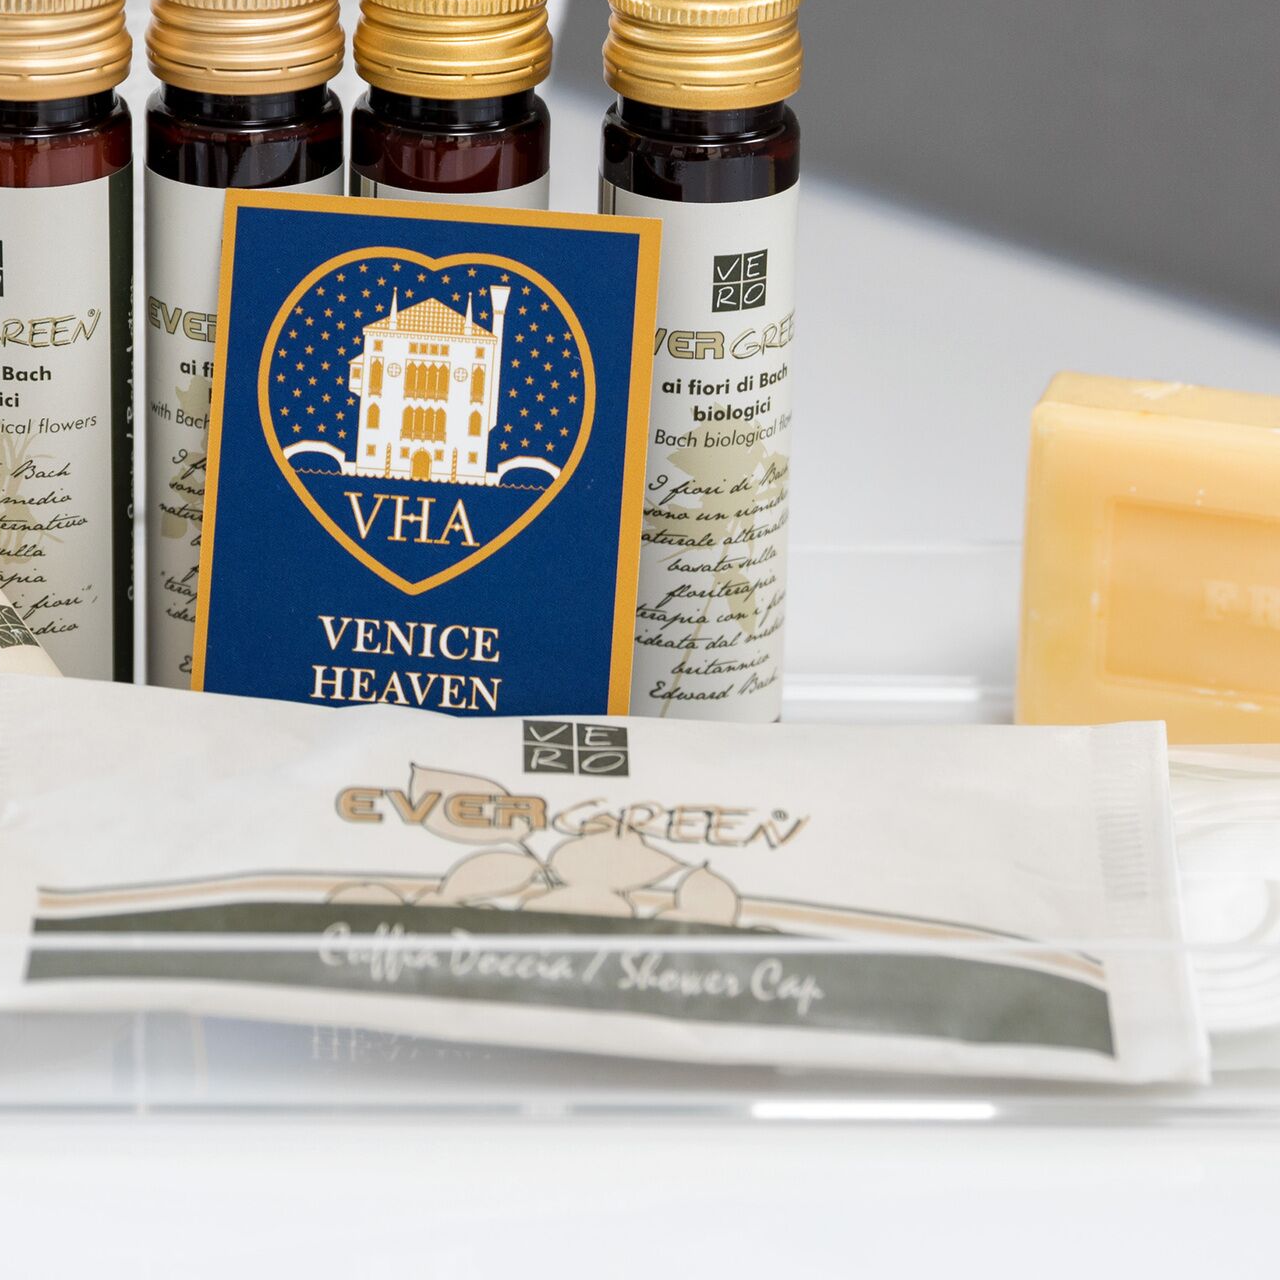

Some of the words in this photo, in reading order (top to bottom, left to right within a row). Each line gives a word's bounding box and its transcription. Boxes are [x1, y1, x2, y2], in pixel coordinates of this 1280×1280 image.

[2, 365, 53, 382] Bach
[179, 359, 197, 375] ai
[662, 378, 681, 395] ai
[688, 378, 730, 397] fiori
[736, 375, 754, 394] di
[759, 362, 788, 389] Bach
[150, 398, 171, 421] with
[692, 395, 771, 423] biologici
[38, 414, 98, 435] flowers
[655, 428, 698, 448] Bach
[703, 417, 778, 449] biological
[10, 459, 71, 480] Bach
[659, 478, 724, 507] fiori
[344, 491, 480, 547] VHA
[667, 554, 748, 573] basato
[715, 611, 750, 624] con
[318, 615, 500, 663] VENICE
[705, 631, 743, 651] dal
[310, 665, 502, 712] HEAVEN
[649, 679, 734, 702] Edward
[335, 786, 548, 831] EVER
[617, 946, 740, 999] Shower
[750, 957, 826, 1017] Cap
